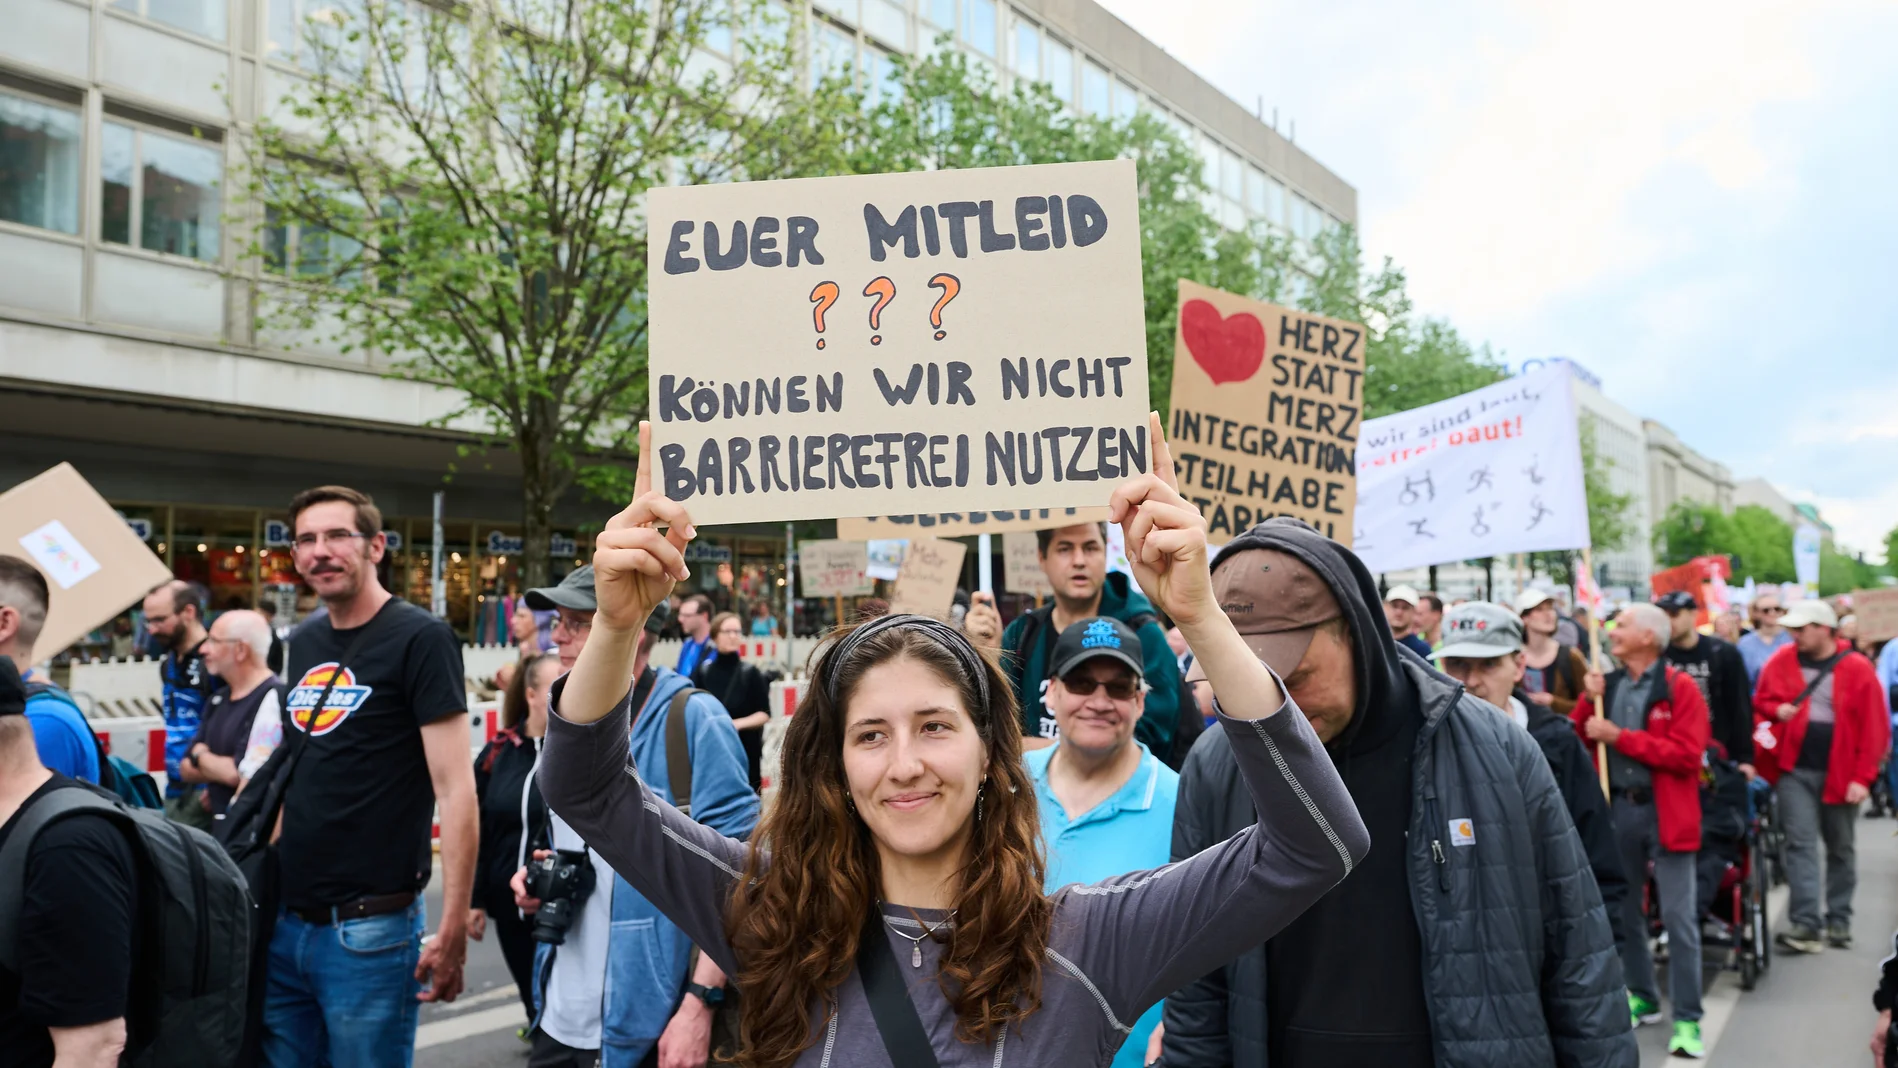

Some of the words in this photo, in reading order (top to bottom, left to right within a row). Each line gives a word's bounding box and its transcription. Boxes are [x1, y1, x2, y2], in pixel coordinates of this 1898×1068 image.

[663, 215, 825, 275] EUER
[863, 194, 1109, 262] MITLEID
[1279, 315, 1361, 364] HERZ
[659, 371, 843, 423] KÖNNEN
[872, 361, 976, 406] WIR
[1001, 356, 1132, 400] NICHT
[1271, 354, 1362, 401] STATT
[1268, 391, 1359, 442] MERZ
[1367, 428, 1409, 448] wir
[1418, 406, 1472, 438] sind
[659, 432, 969, 502] BARRIEREFREI
[985, 425, 1147, 486] NUTZEN
[1173, 408, 1356, 477] INTEGRATION
[290, 688, 357, 706] Dicies
